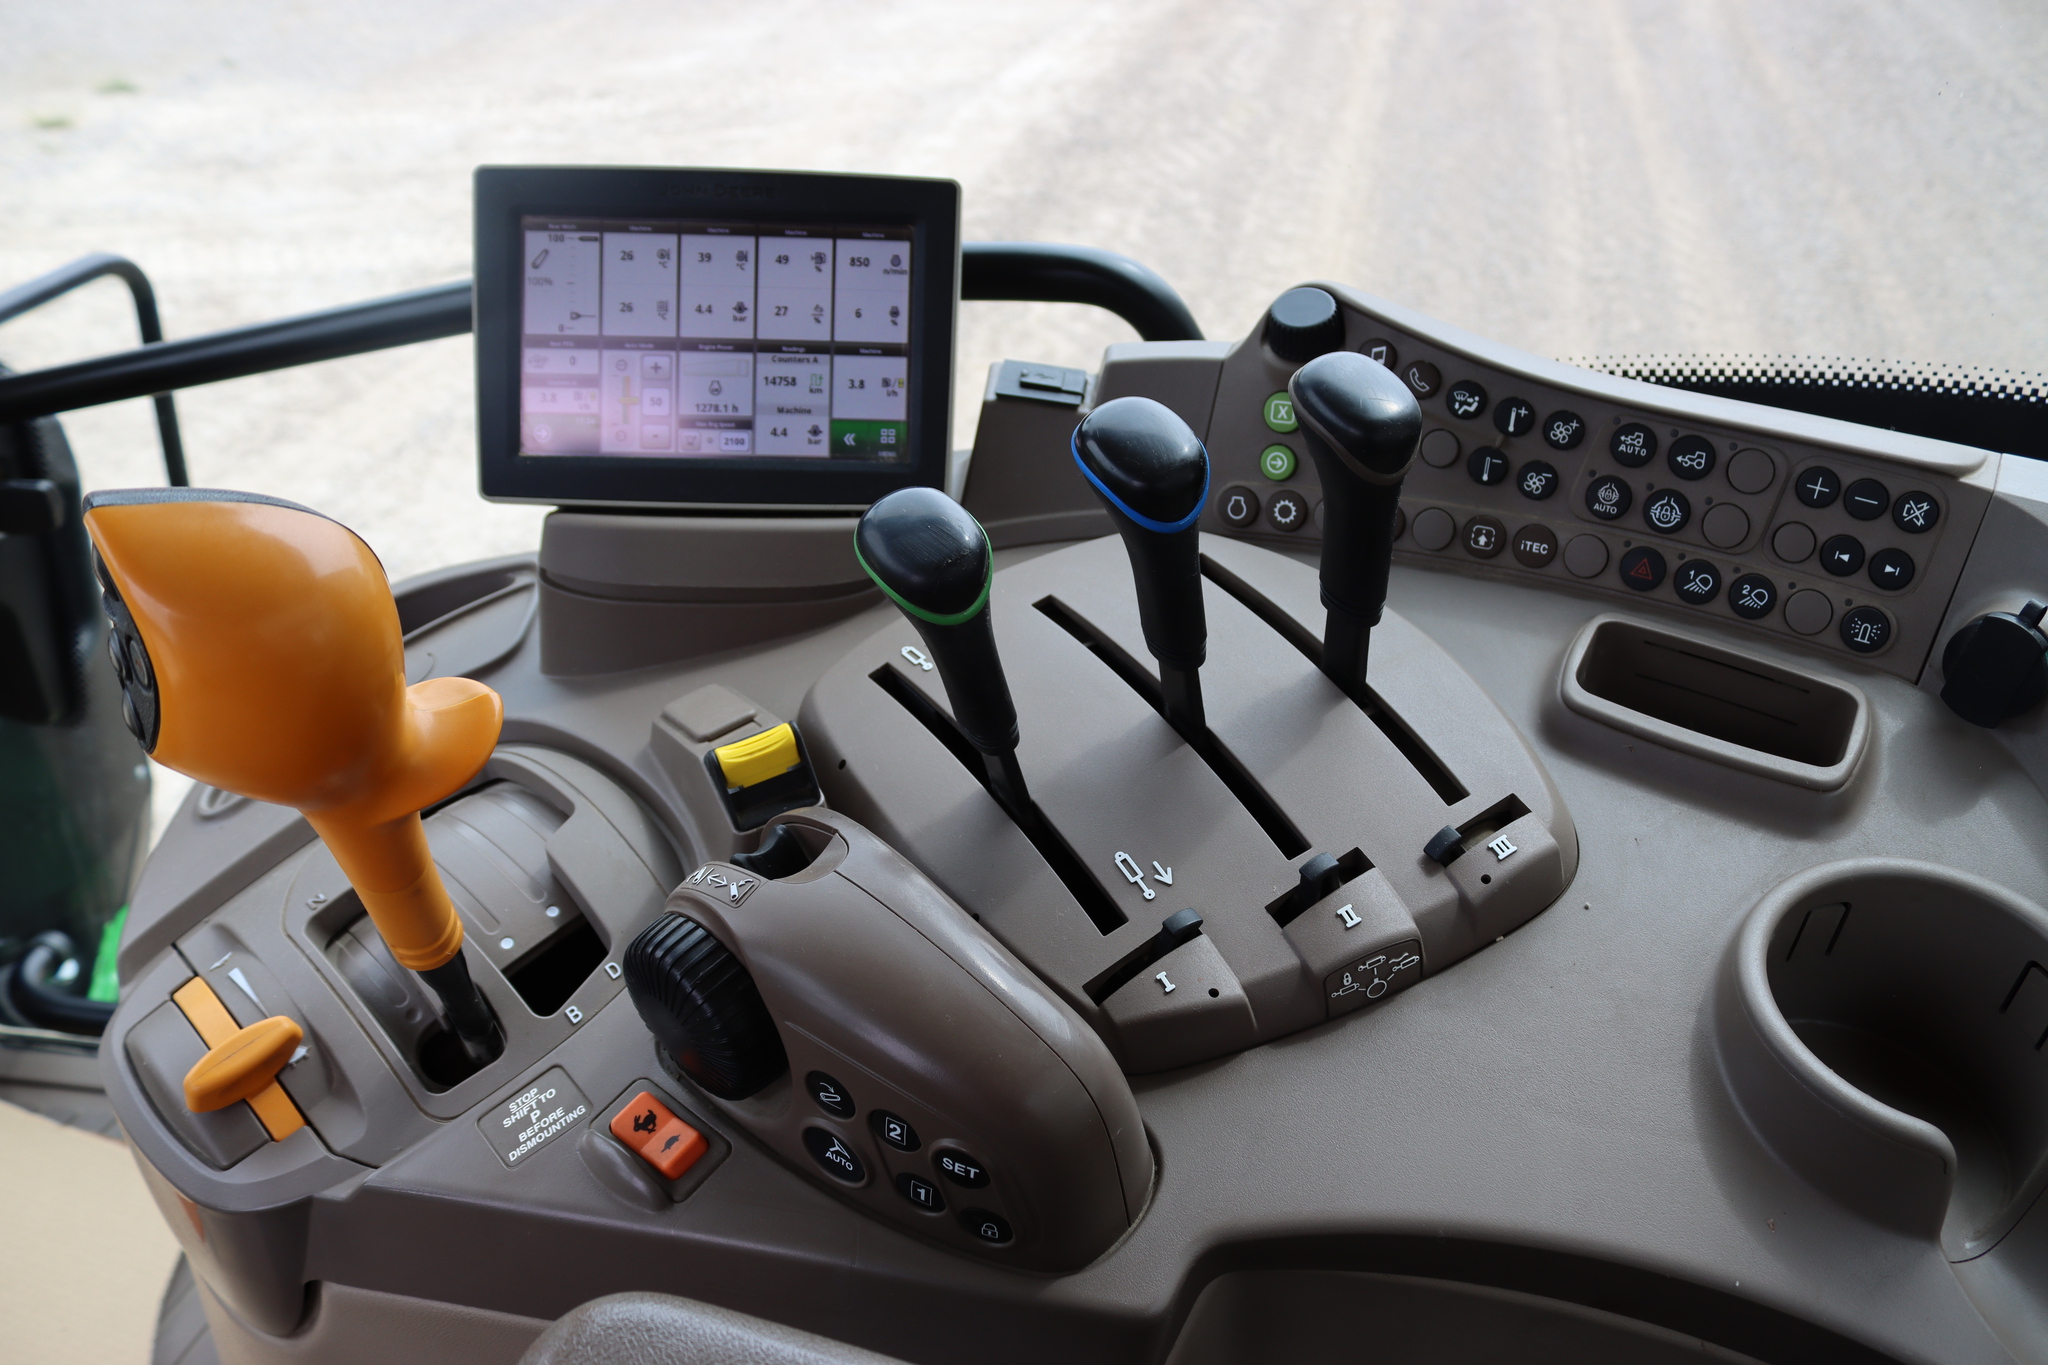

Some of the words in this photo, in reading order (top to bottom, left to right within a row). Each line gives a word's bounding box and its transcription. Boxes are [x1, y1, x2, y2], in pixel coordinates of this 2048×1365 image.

[548, 234, 565, 242] 100
[620, 250, 634, 261] 26
[698, 252, 712, 263] 39
[775, 254, 789, 265] 49
[849, 256, 870, 267] 850
[883, 268, 908, 276] n/min
[527, 277, 553, 286] 100%
[619, 302, 633, 313] 26
[695, 304, 713, 315] 4.4
[774, 306, 788, 316] 27
[855, 308, 862, 318] 6
[733, 314, 747, 322] bar
[569, 355, 576, 366] 0
[772, 355, 811, 364] Counters
[763, 376, 797, 387] 14758
[848, 378, 865, 389] 3.8
[809, 386, 823, 394] km
[650, 397, 662, 406] 50
[695, 403, 728, 413] 1278.1
[732, 404, 738, 413] h
[777, 406, 812, 415] Machine
[770, 427, 788, 437] 4.4
[724, 438, 745, 446] 2100
[807, 437, 822, 445] bar
[1618, 444, 1647, 457] AUTO
[1593, 503, 1617, 515] AUTO
[1521, 540, 1548, 554] iTEC
[1689, 570, 1695, 580] 1
[1742, 585, 1750, 595] 2
[604, 962, 622, 979] D
[564, 1005, 583, 1024] B
[508, 1088, 538, 1112] STOP
[502, 1100, 537, 1128] SHIFT
[538, 1088, 556, 1103] TO
[530, 1110, 541, 1123] P
[518, 1107, 565, 1142] BEFORE
[508, 1105, 586, 1161] DISMOUNTING
[889, 1123, 902, 1140] 2
[825, 1151, 853, 1171] AUTO
[942, 1157, 980, 1179] SET
[917, 1188, 926, 1201] 1
